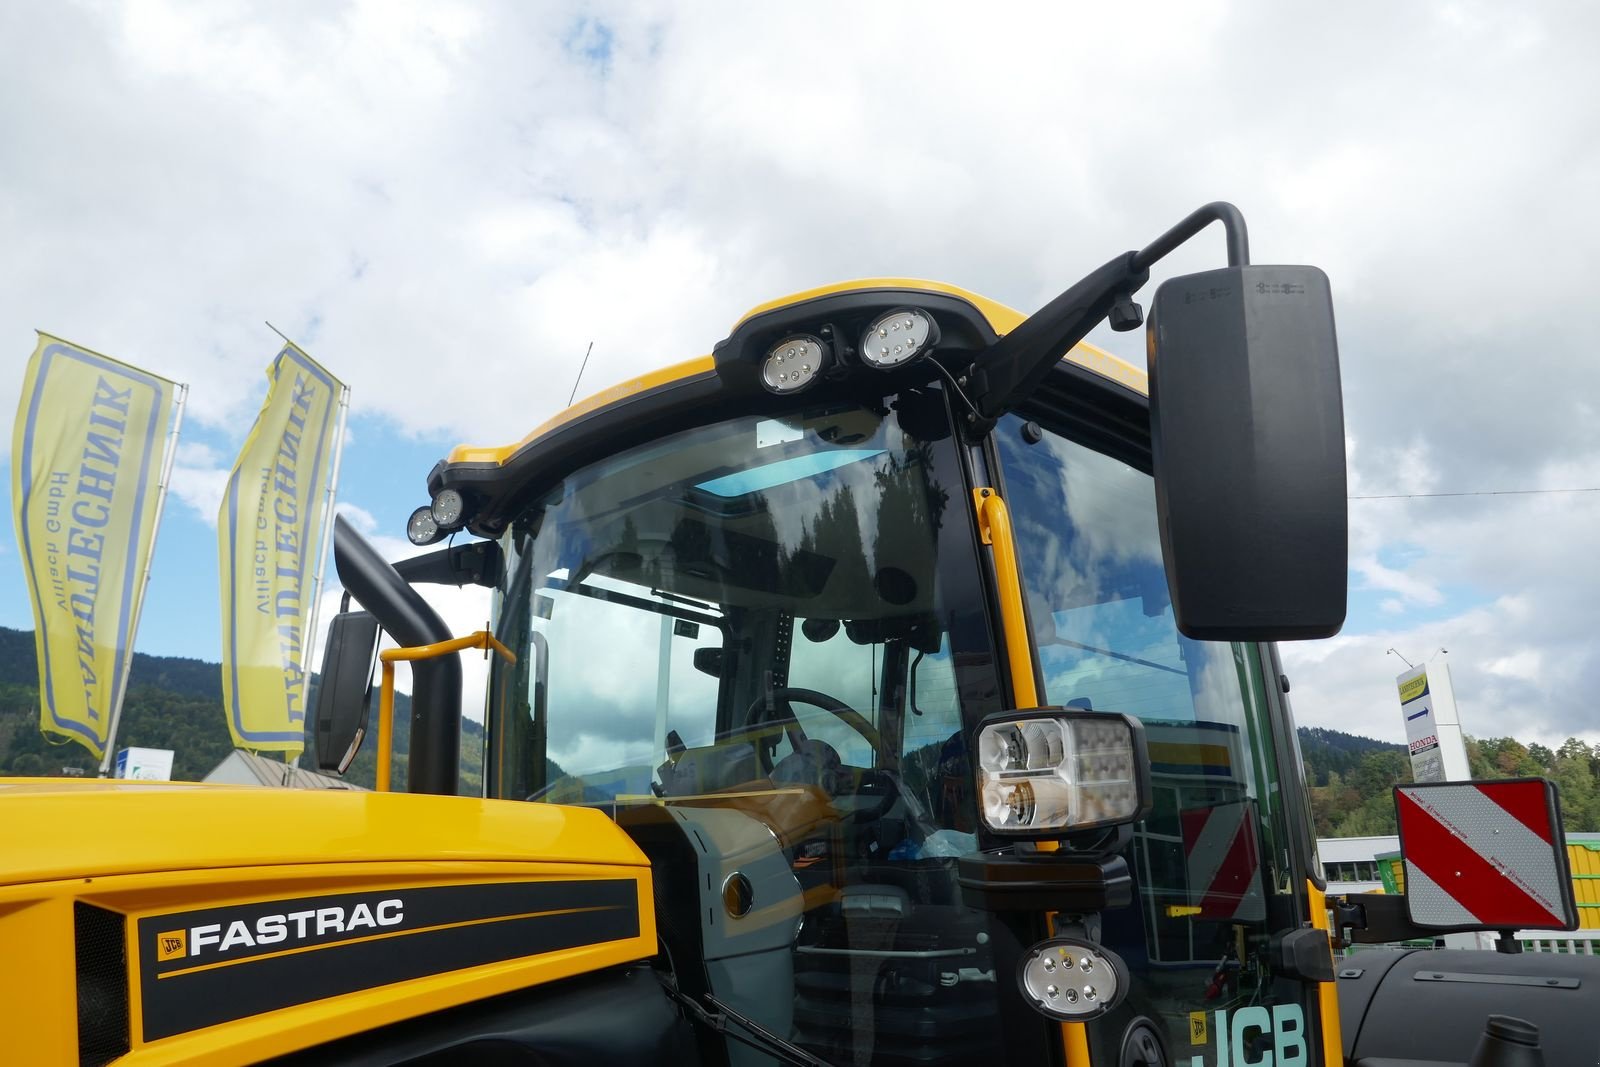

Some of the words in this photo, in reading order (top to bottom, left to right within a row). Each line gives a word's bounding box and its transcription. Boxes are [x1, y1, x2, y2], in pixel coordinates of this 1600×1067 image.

[1409, 735, 1438, 750] HONDA
[163, 937, 184, 954] JCB
[190, 899, 404, 956] FASTRAC
[1191, 1003, 1307, 1067] JCB
